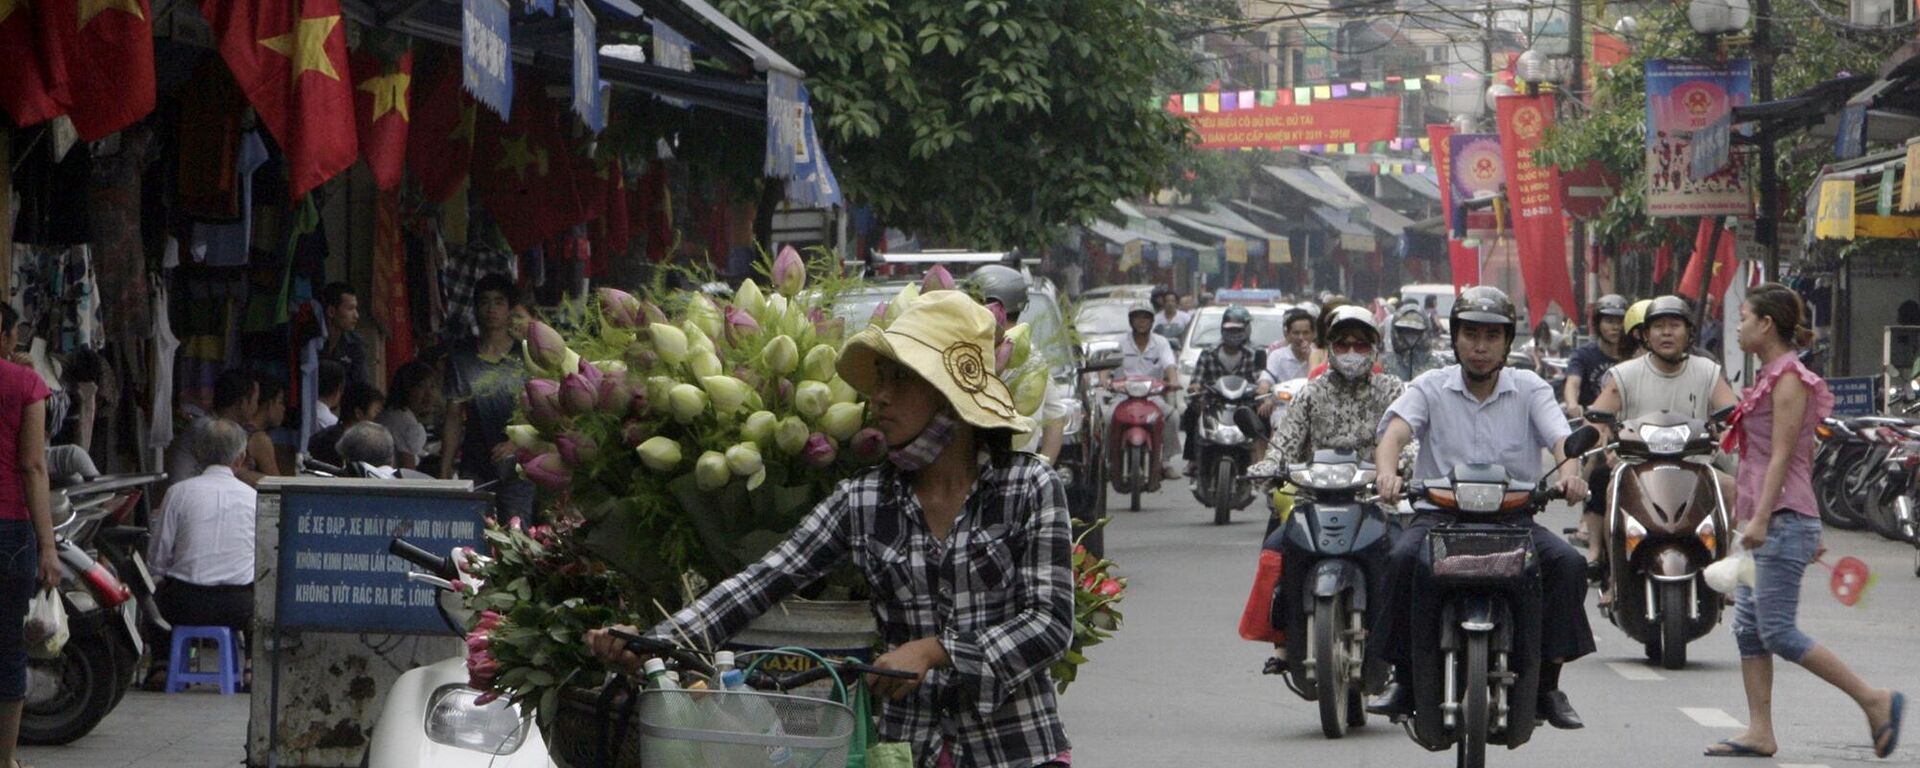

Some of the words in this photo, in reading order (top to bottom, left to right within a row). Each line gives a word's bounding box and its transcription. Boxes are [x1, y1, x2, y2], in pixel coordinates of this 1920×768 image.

[312, 516, 324, 534] XE
[350, 517, 362, 535] XE
[363, 514, 385, 536] MÁY
[296, 548, 322, 570] KHÔNG
[323, 552, 342, 571] KINH
[343, 552, 370, 571] DOANH
[295, 581, 329, 603] KHÔNG
[352, 583, 373, 604] RÁC
[375, 587, 389, 605] RA
